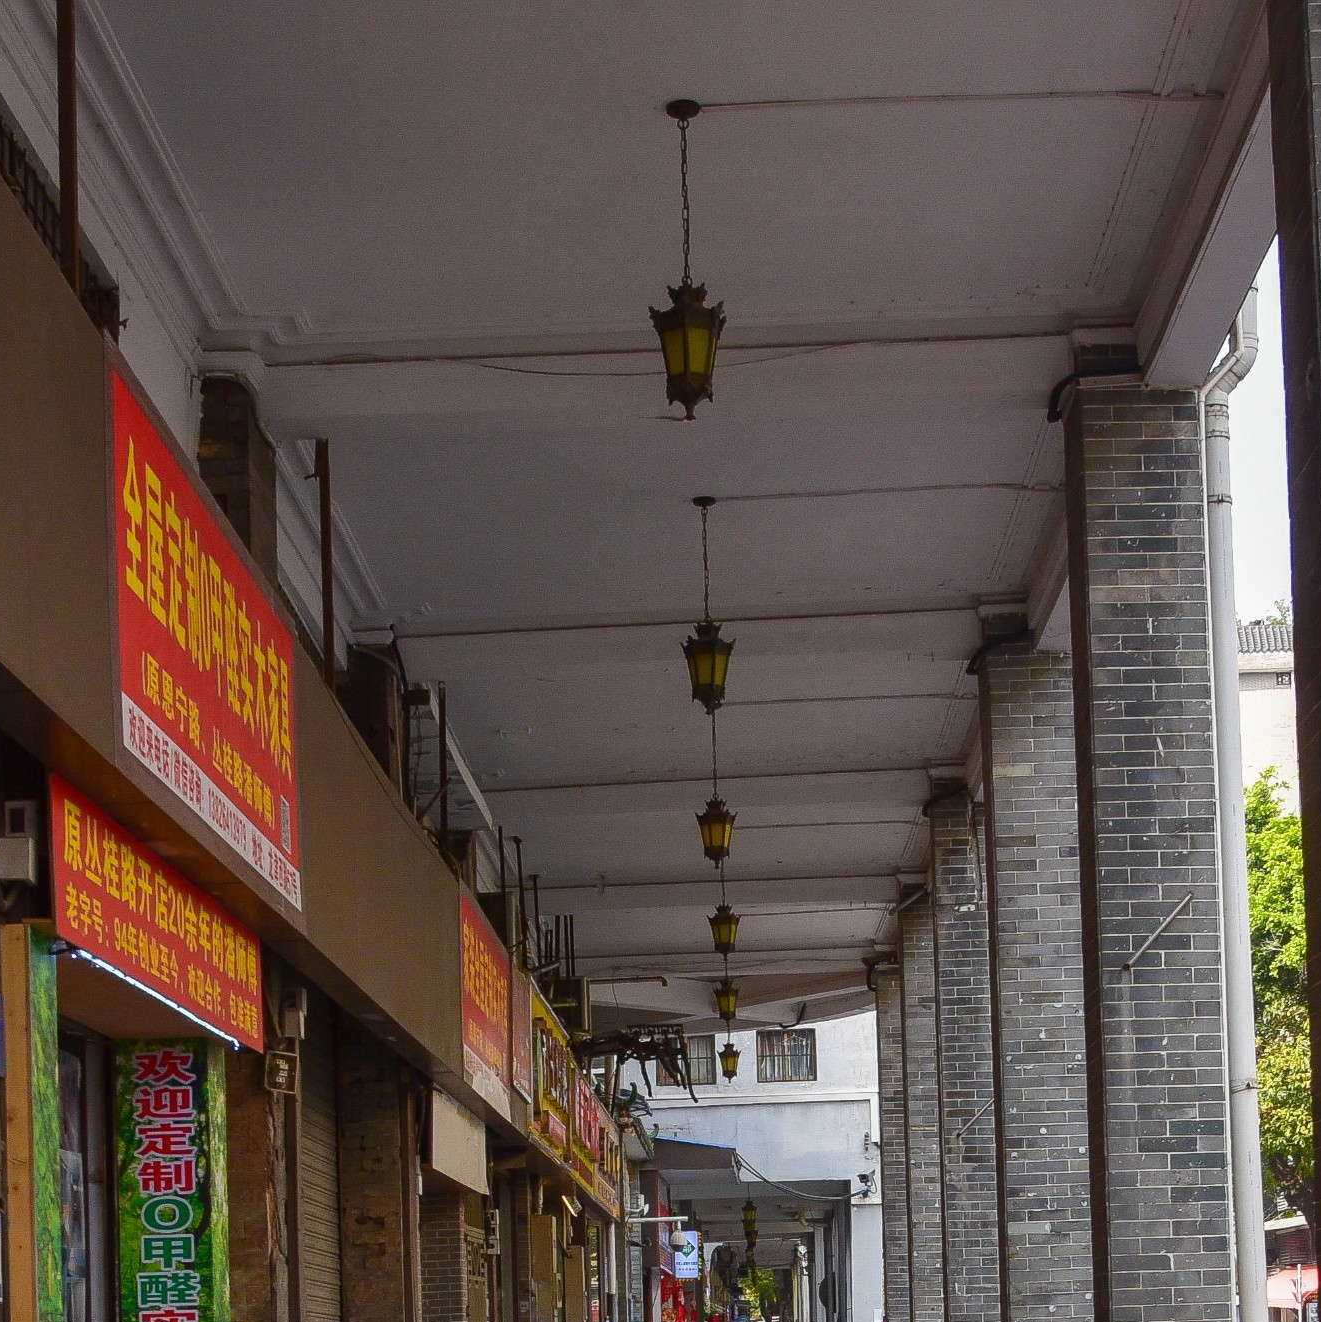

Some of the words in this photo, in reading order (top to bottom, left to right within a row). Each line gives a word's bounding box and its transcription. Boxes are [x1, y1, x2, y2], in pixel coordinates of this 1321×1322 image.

[64, 798, 258, 996] 原丛桂路开店20余年的潘师傅
